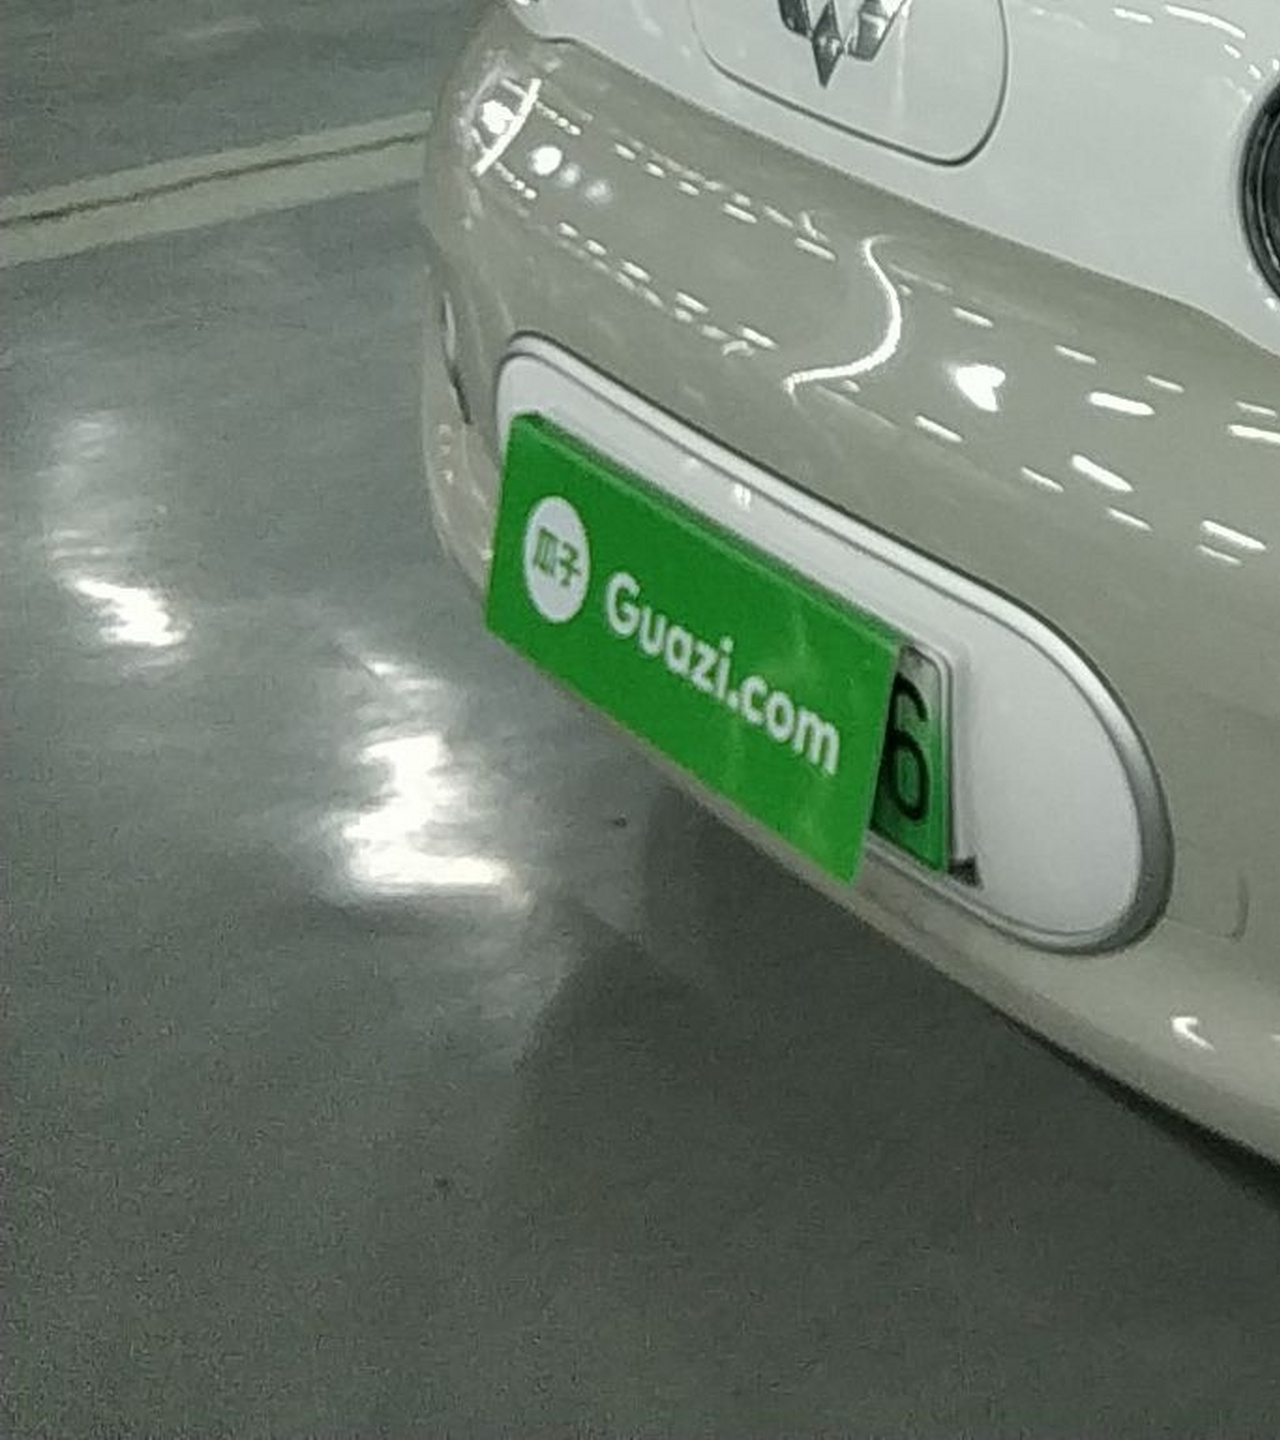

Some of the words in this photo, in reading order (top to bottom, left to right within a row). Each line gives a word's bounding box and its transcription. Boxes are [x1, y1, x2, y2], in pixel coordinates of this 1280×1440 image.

[532, 526, 582, 587] 瓜子
[604, 570, 841, 777] Guazi.com
[885, 672, 930, 822] 6
